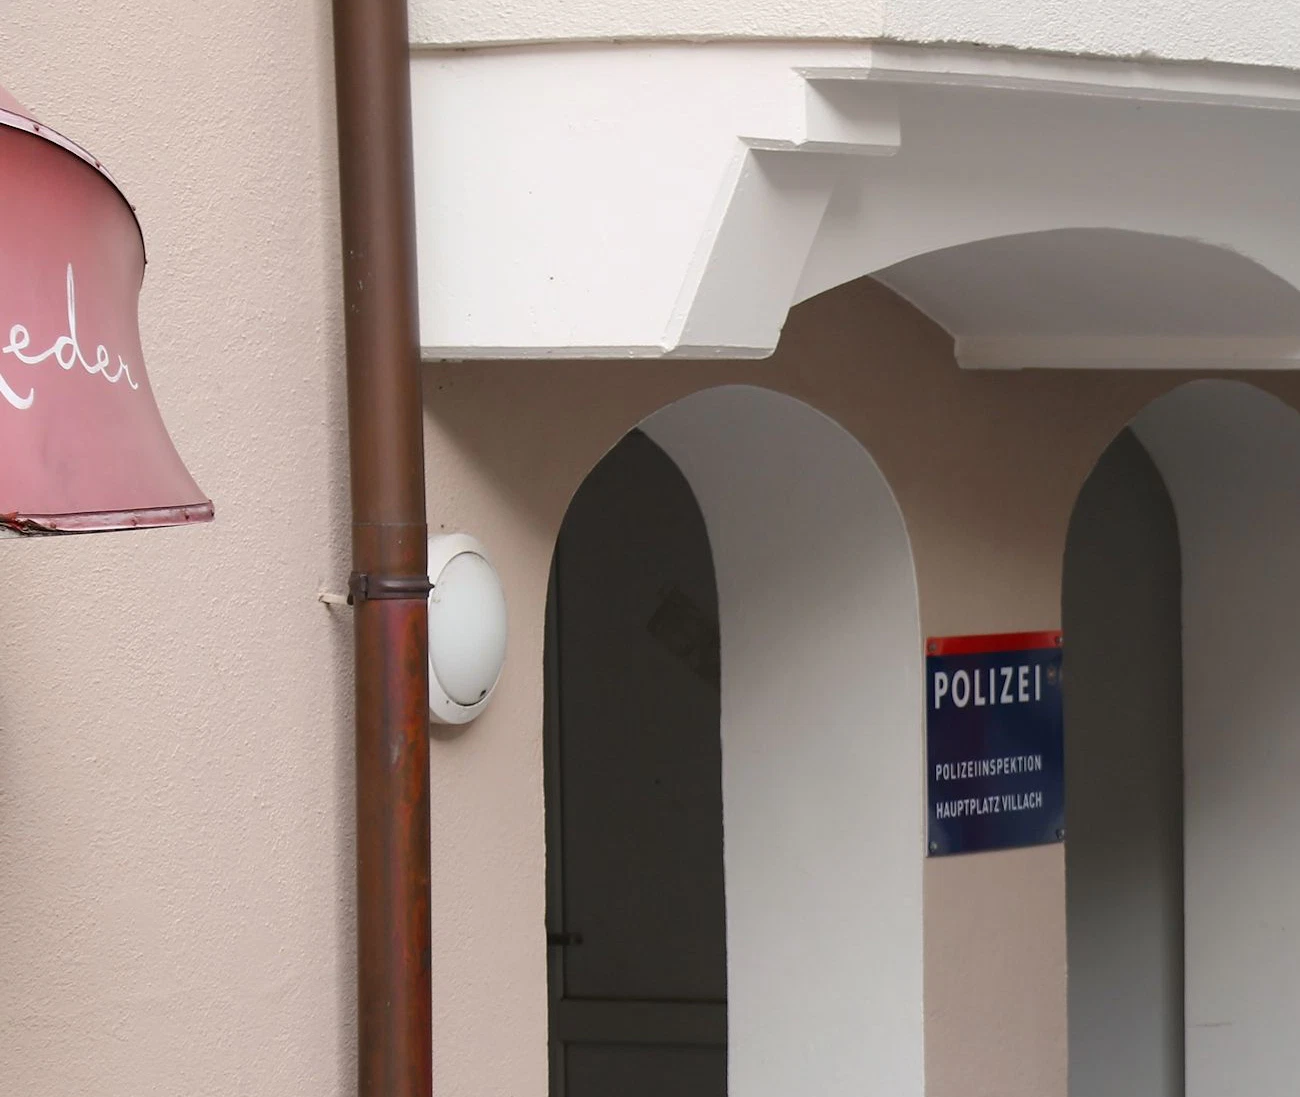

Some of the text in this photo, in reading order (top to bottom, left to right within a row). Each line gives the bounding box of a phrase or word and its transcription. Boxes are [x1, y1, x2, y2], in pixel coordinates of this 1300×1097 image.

[934, 664, 1041, 710] POLIZEI
[935, 754, 1043, 781] POLIZEIINSPEKTION
[936, 791, 1043, 820] HAUPTPLATZ VILLACH
